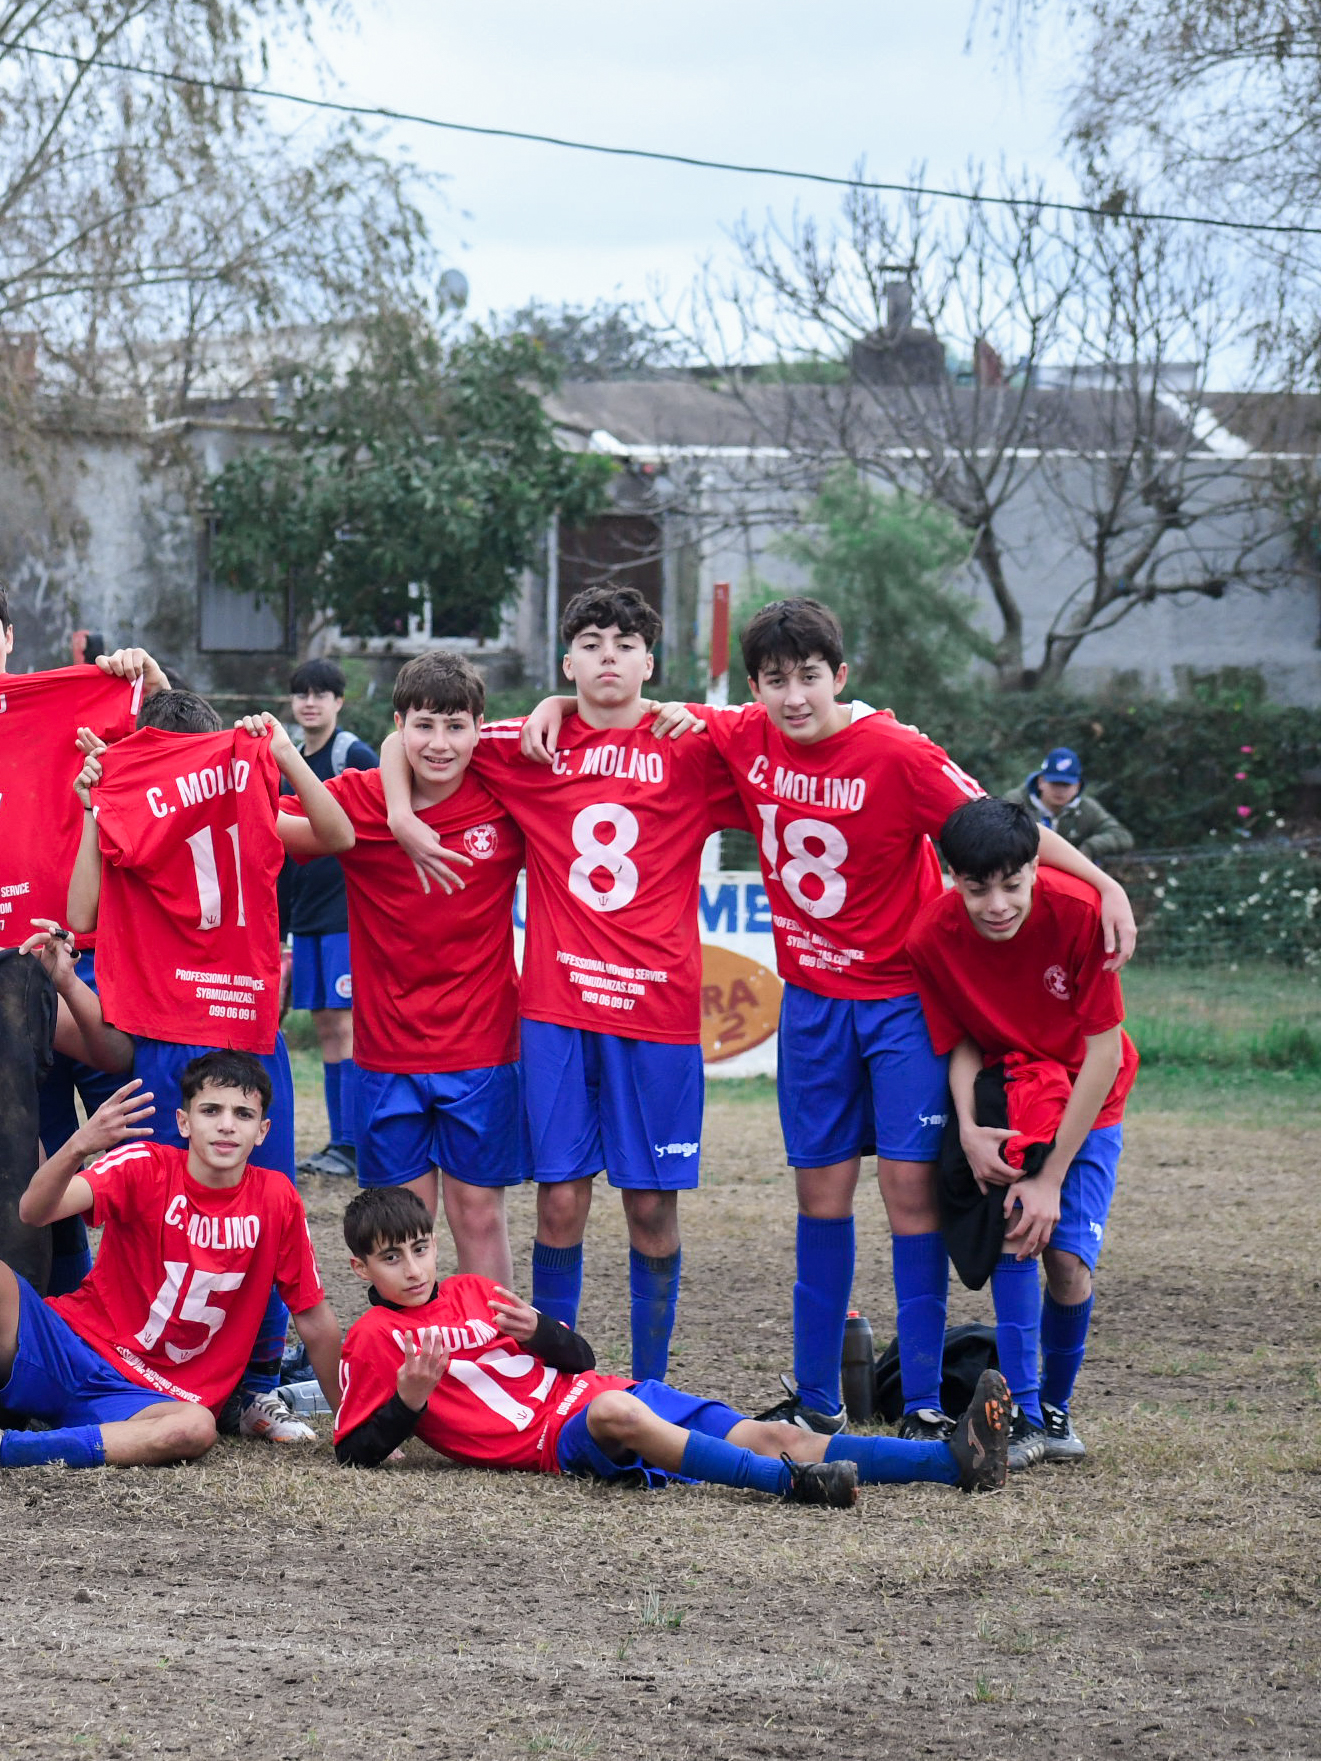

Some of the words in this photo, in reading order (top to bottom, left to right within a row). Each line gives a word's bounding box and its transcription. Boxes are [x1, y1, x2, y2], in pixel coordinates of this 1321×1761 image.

[551, 749, 573, 776] C.
[747, 754, 770, 790] C.
[773, 766, 867, 812] MOLINO
[146, 786, 176, 818] C.
[568, 802, 640, 912] 8
[756, 803, 849, 919] 18
[0, 882, 30, 898] SERVICE
[175, 968, 232, 985] PROFESSIONAL
[569, 971, 645, 996] SYBMUDANZAS.COM
[634, 968, 668, 983] SERVICE
[209, 1005, 226, 1018] 099
[226, 1007, 238, 1019] 06
[239, 1008, 250, 1020] 09
[581, 990, 599, 1004] 099
[598, 993, 611, 1007] 06
[610, 996, 623, 1009] 09
[622, 998, 636, 1010] 07
[164, 1194, 188, 1230] C.
[187, 1213, 260, 1249] MOLINO
[133, 1260, 246, 1364] 15
[170, 1385, 202, 1403] SERVICE
